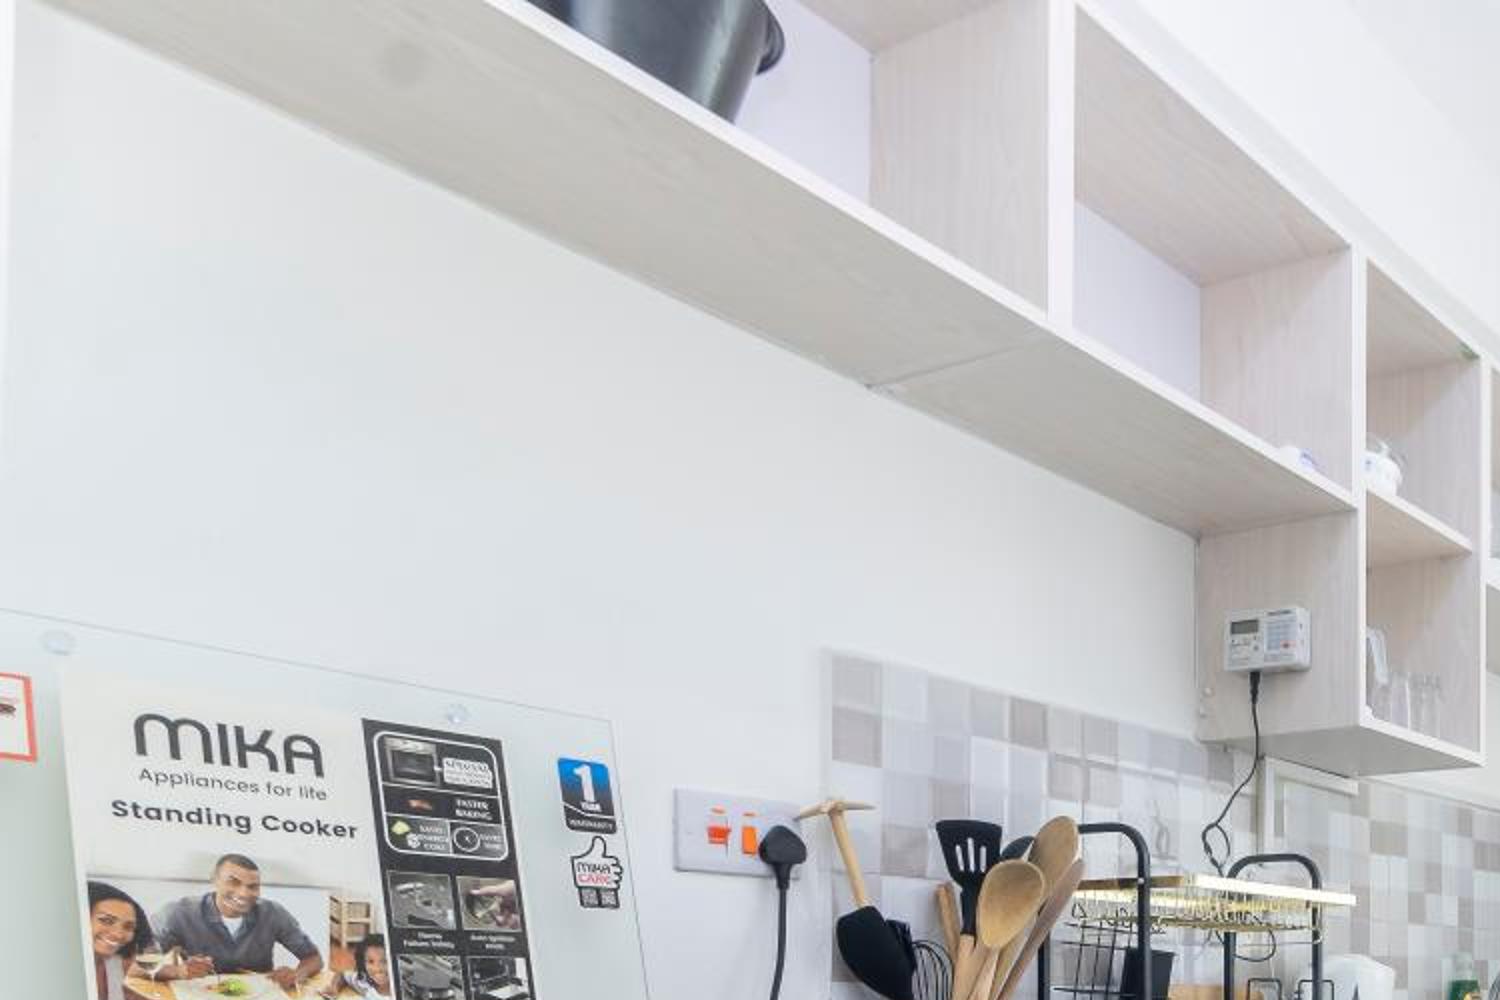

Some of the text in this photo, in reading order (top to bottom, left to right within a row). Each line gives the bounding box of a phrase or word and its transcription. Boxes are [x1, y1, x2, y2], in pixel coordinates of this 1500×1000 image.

[133, 712, 325, 779] MIKA
[139, 767, 328, 801] Appliances for life
[111, 799, 359, 839] Standing Cooker
